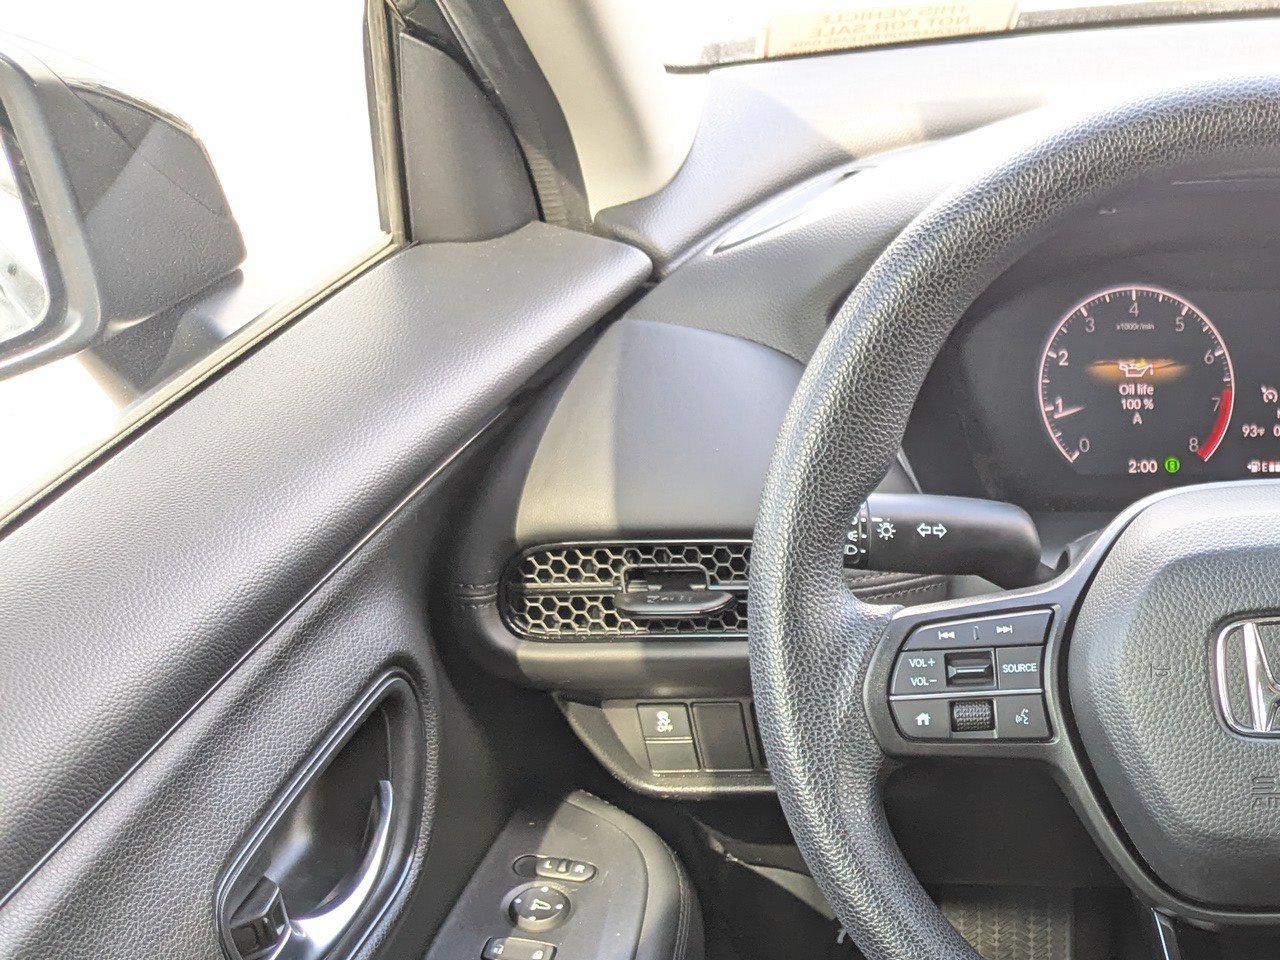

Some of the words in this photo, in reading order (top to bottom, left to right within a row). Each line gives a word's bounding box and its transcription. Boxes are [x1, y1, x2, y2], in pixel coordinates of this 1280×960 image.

[1129, 303, 1139, 317] 4
[1085, 318, 1095, 332] 3
[1175, 318, 1185, 332] 5
[1058, 350, 1069, 366] 2
[1204, 350, 1214, 365] 6
[1118, 384, 1135, 396] Oil
[1137, 384, 1154, 396] life
[1120, 398, 1141, 410] 100
[1143, 399, 1154, 410] %
[1211, 397, 1221, 412] 7
[1132, 412, 1143, 425] A
[1079, 438, 1090, 453] 0
[1189, 437, 1199, 452] 8
[1128, 459, 1158, 474] 2:00
[1002, 662, 1037, 674] SOURCE
